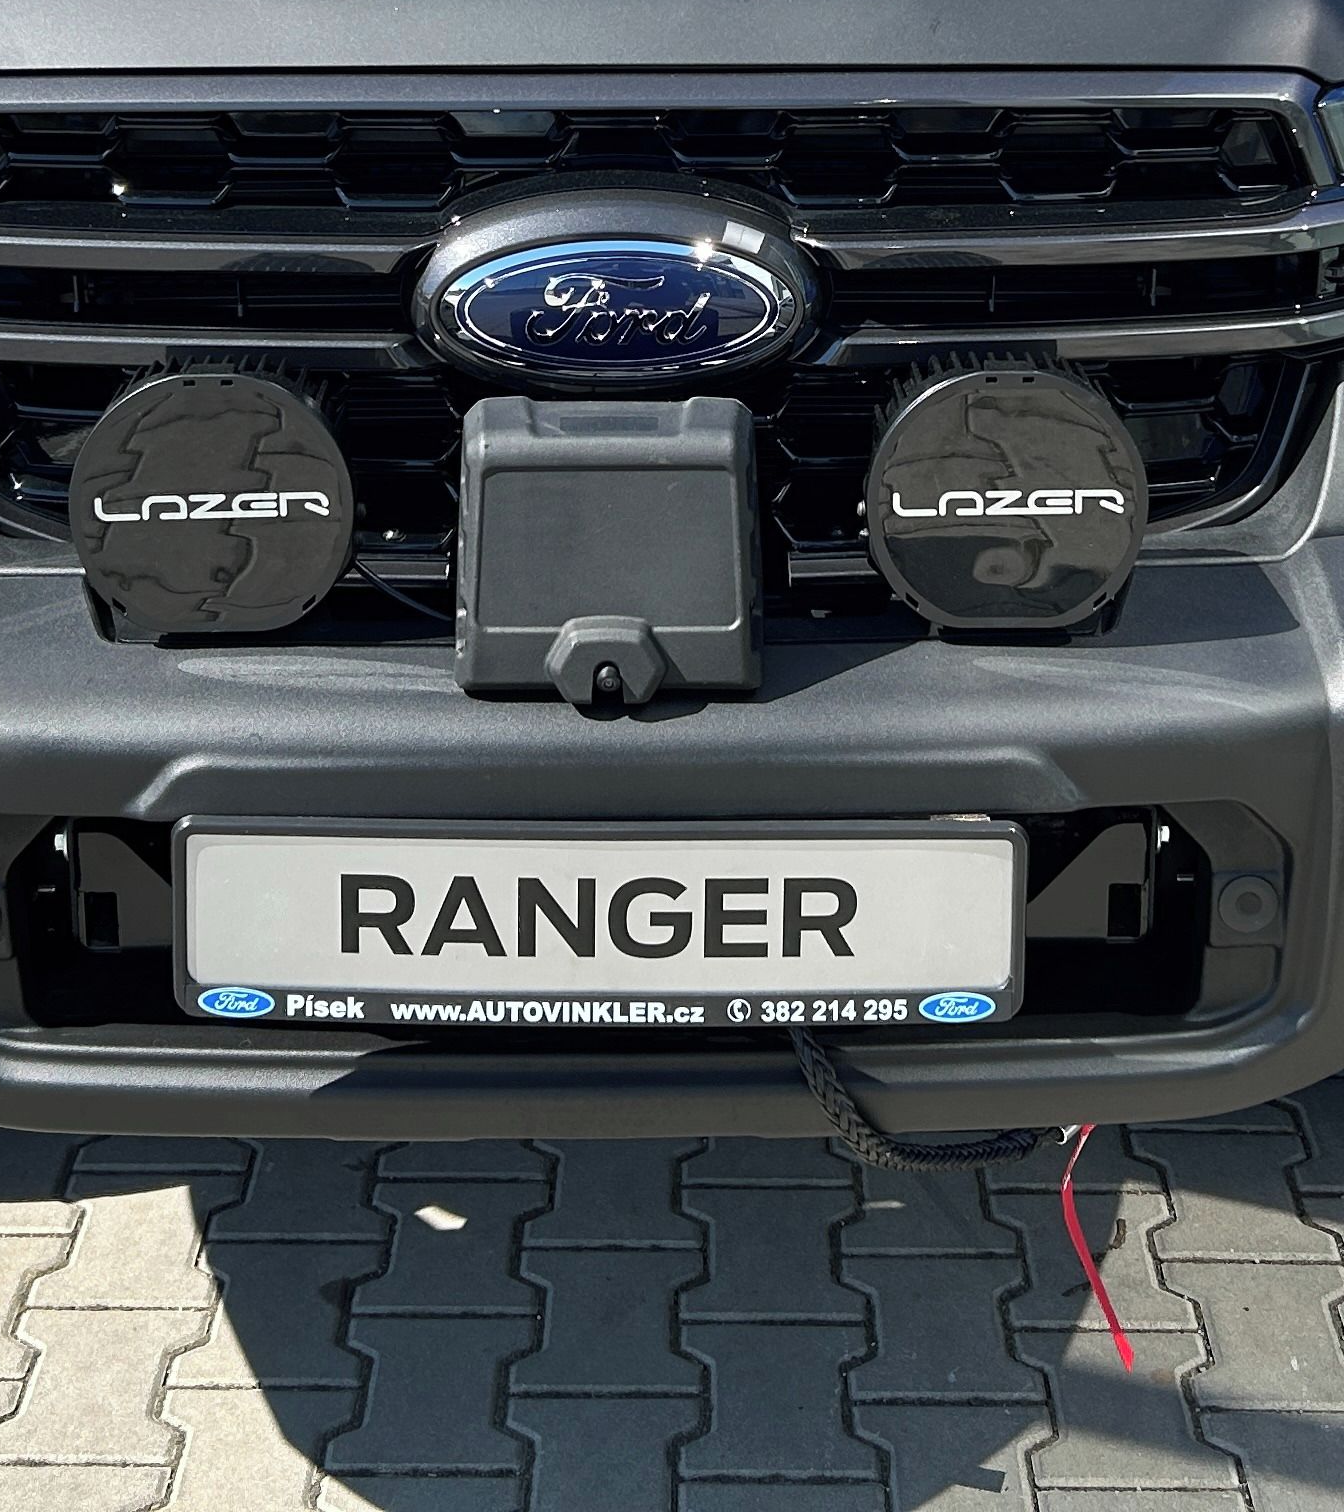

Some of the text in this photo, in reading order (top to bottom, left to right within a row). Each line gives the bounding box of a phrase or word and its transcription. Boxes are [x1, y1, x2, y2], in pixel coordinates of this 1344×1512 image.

[524, 273, 711, 346] Ford
[93, 491, 330, 522] LAZER
[892, 489, 1125, 517] LAZER
[340, 873, 858, 959] RANGER
[214, 992, 978, 1023] Ford Písek www.AUTOVINKLER.cz 382 214 295 Ford
